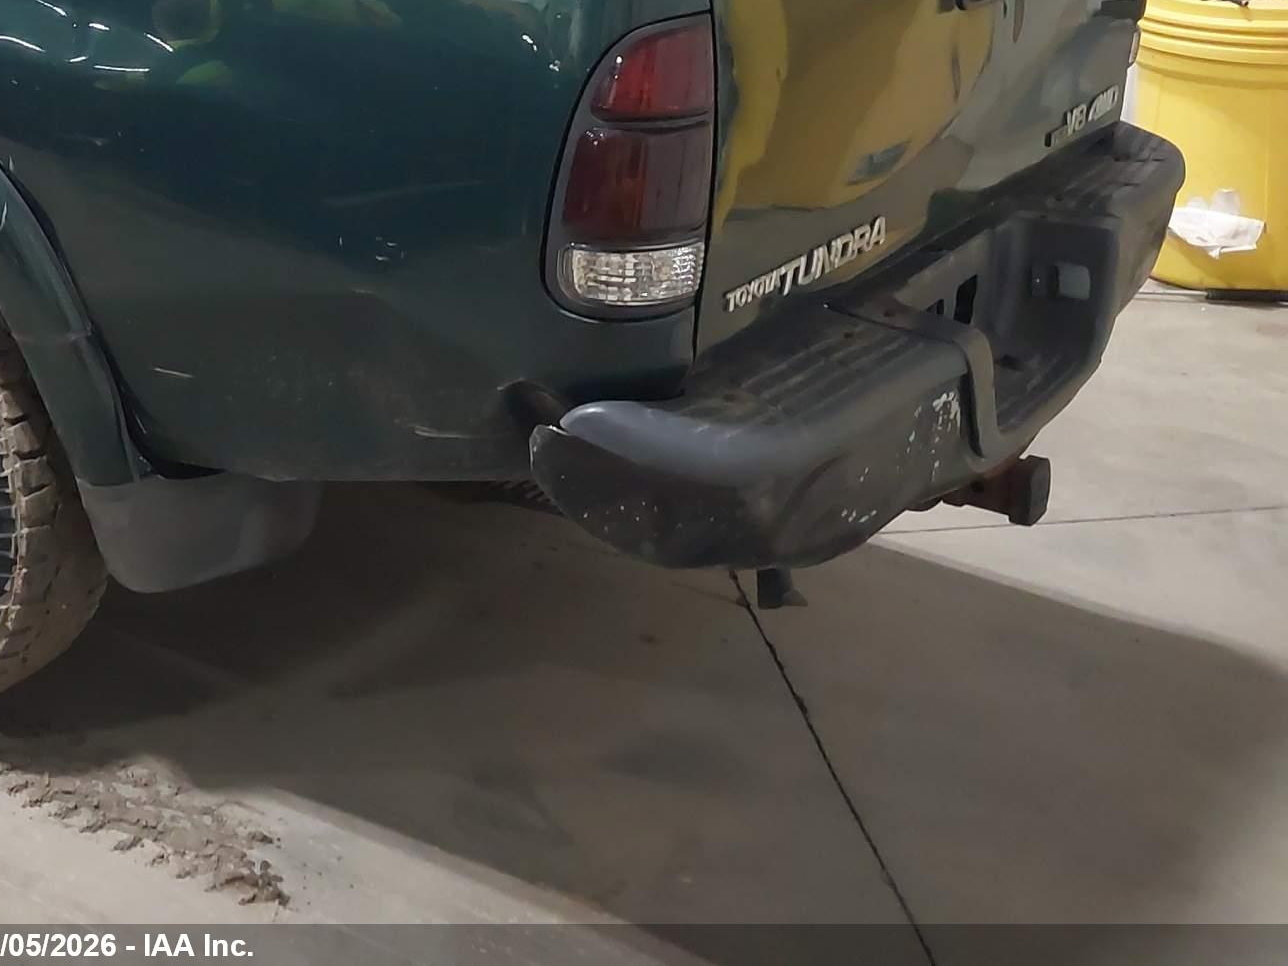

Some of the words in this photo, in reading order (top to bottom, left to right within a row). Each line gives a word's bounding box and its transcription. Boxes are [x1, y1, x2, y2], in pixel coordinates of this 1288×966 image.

[1065, 104, 1087, 136] V8
[725, 273, 782, 313] TOYOTA
[778, 215, 887, 297] TUNDRA
